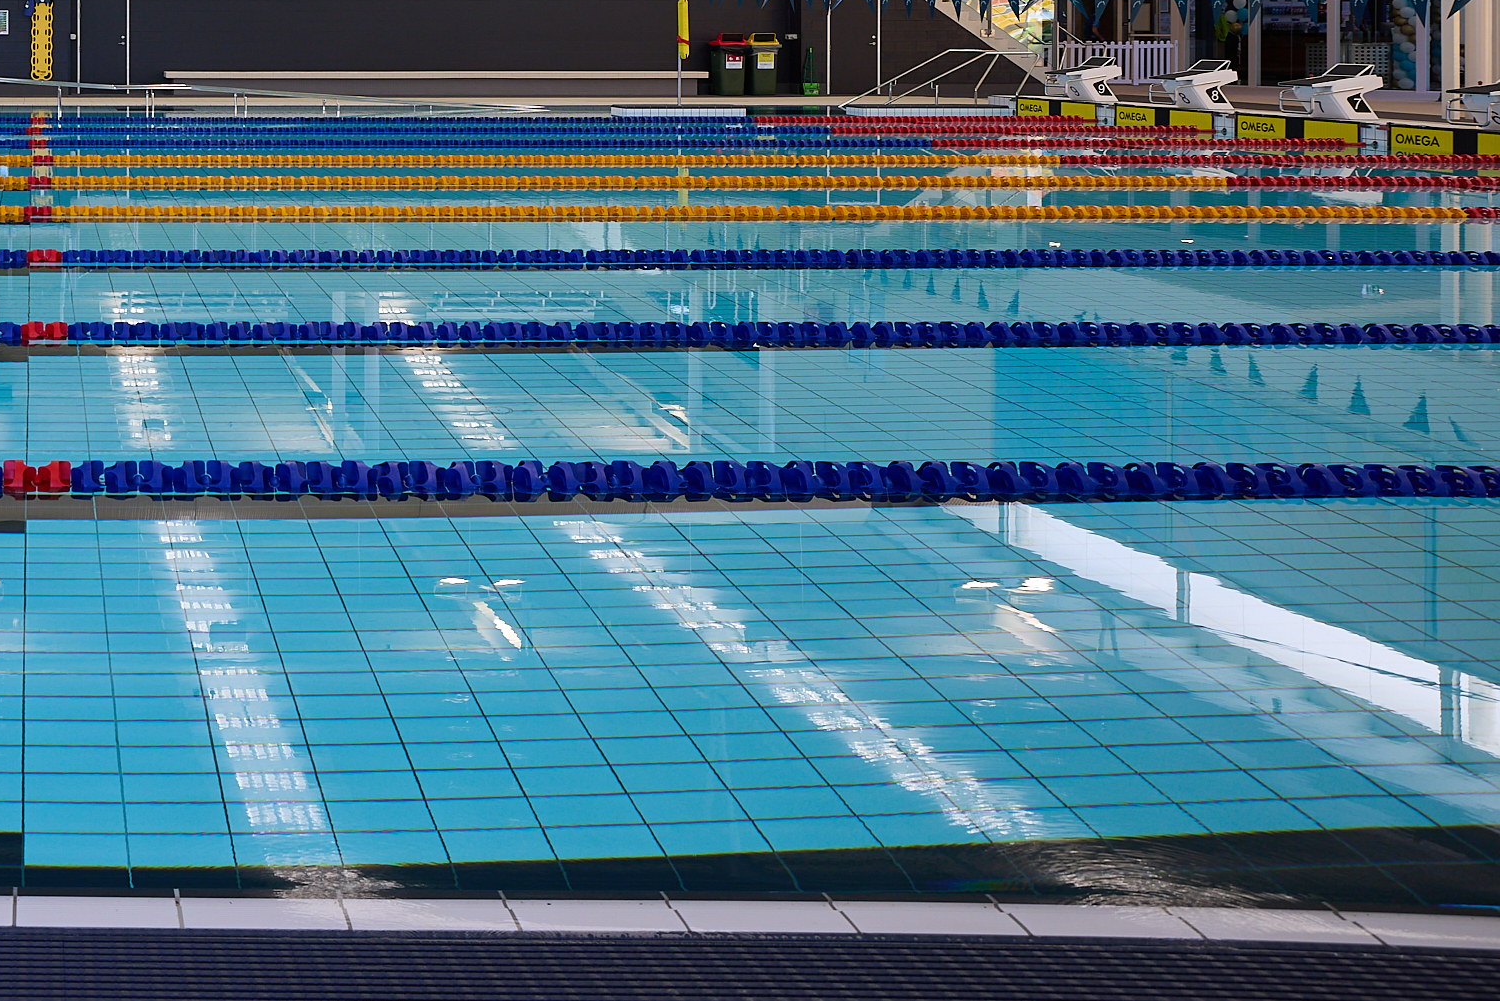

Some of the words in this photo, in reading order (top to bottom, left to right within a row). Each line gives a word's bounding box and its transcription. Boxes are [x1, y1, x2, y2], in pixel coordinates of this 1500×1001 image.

[1098, 84, 1106, 94] 9
[1211, 90, 1220, 101] 8
[1019, 103, 1043, 113] OMEGA
[1353, 98, 1362, 110] 7
[1119, 111, 1147, 122] OMEGA
[1241, 121, 1276, 133] OMEGA
[1395, 133, 1440, 147] OMEGA
